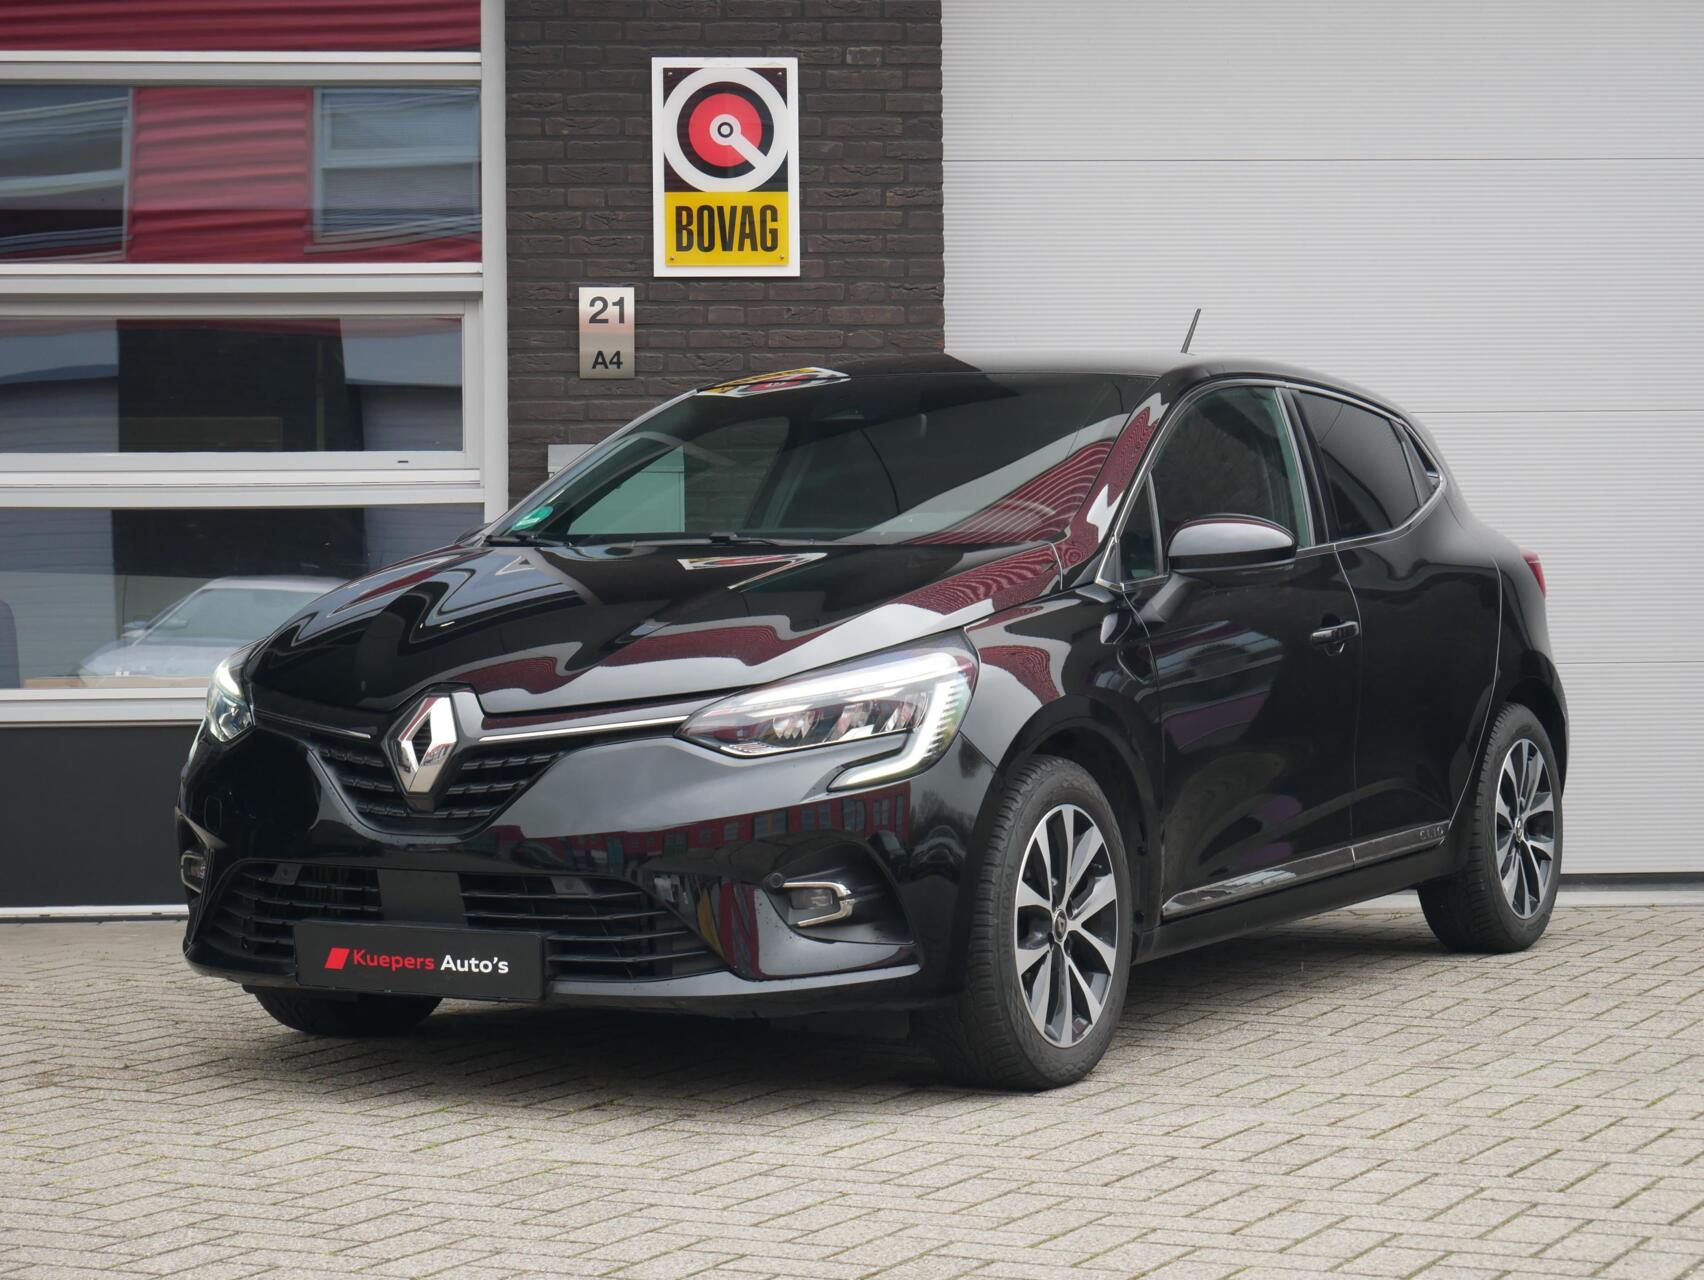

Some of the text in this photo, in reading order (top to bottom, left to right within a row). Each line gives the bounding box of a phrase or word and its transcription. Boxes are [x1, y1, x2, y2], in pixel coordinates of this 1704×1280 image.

[675, 204, 779, 252] BOVAG
[588, 296, 625, 324] 21
[591, 350, 623, 369] A4
[353, 949, 435, 972] Kuepers
